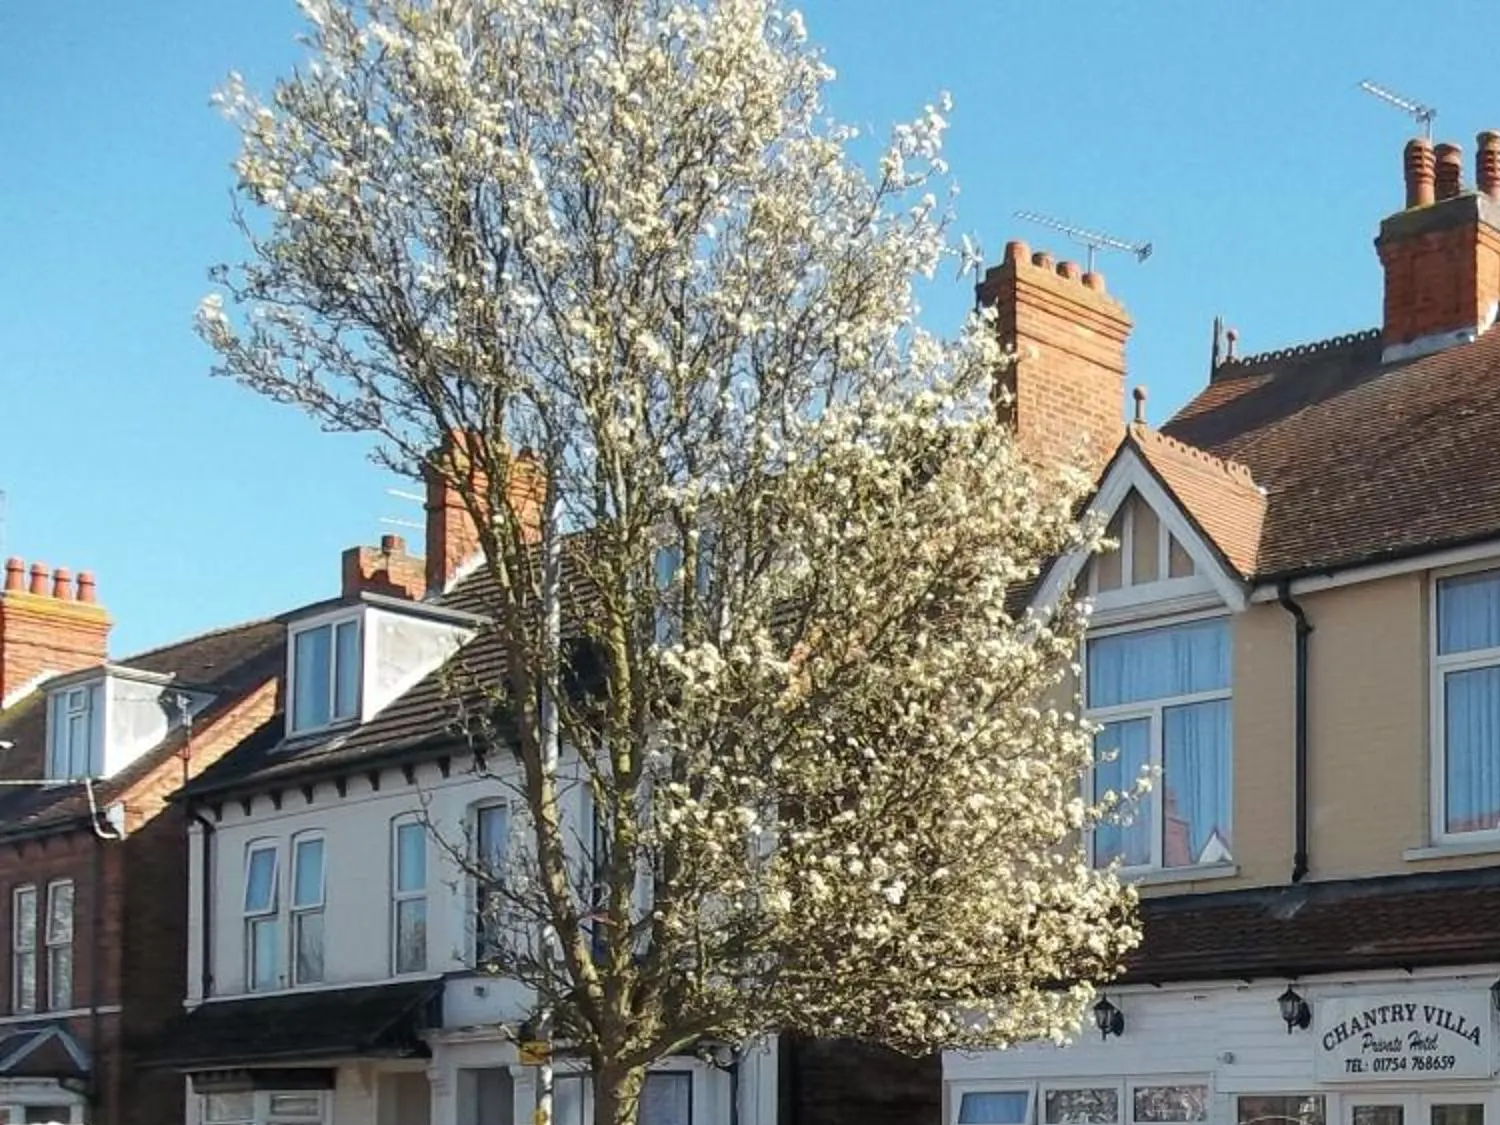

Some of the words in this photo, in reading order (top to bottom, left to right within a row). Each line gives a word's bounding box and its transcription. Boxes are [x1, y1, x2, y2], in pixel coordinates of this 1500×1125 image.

[1323, 1003, 1417, 1051] CHANTRY
[1424, 1005, 1481, 1046] VILLA
[1372, 1056, 1407, 1072] 01754
